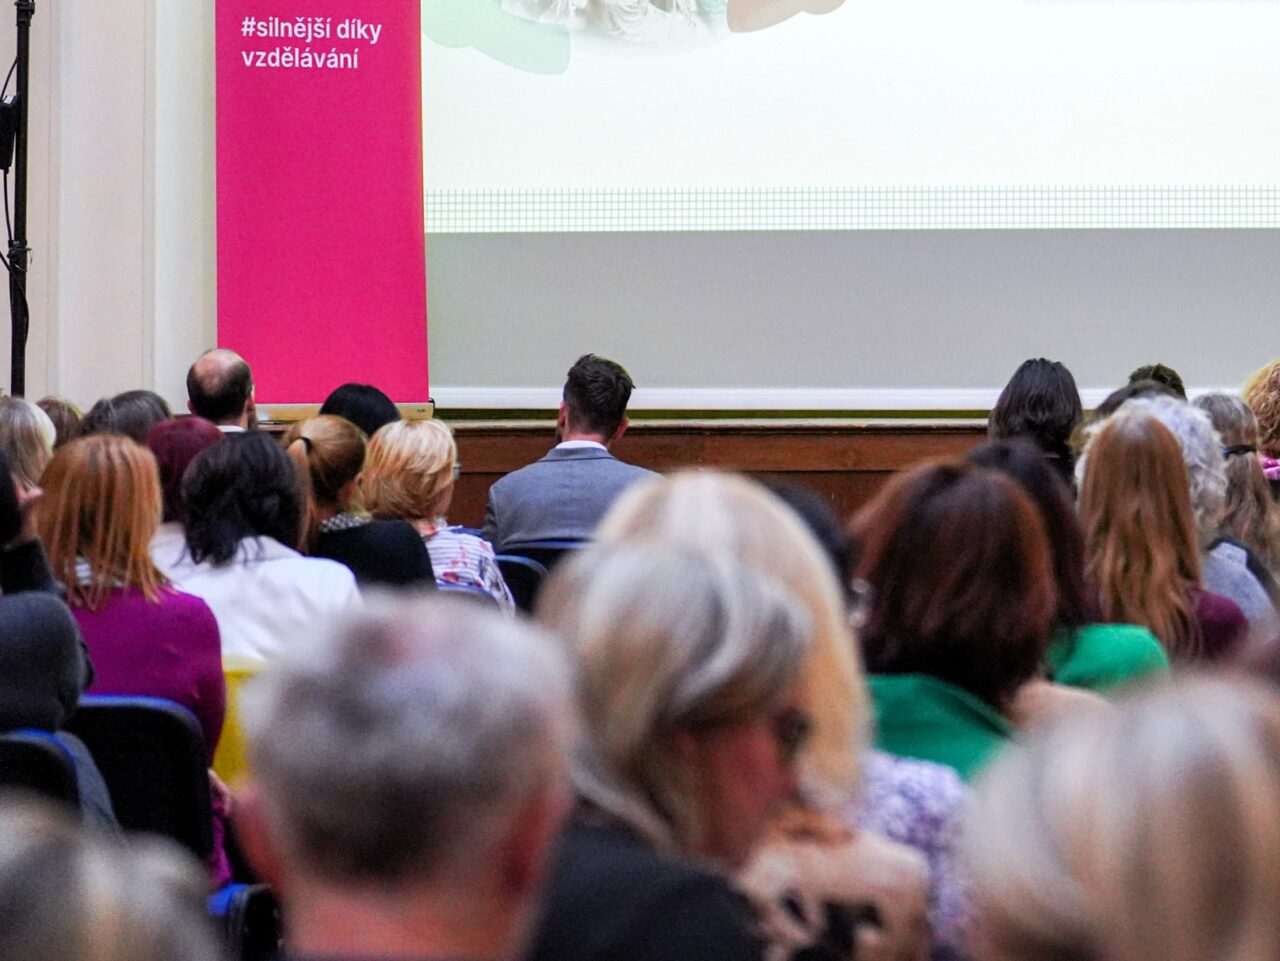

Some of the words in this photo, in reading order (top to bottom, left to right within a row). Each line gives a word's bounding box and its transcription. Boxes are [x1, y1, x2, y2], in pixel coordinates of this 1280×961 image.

[241, 16, 331, 43] #silnější
[336, 18, 382, 45] díky
[241, 46, 359, 68] vzdělávání
